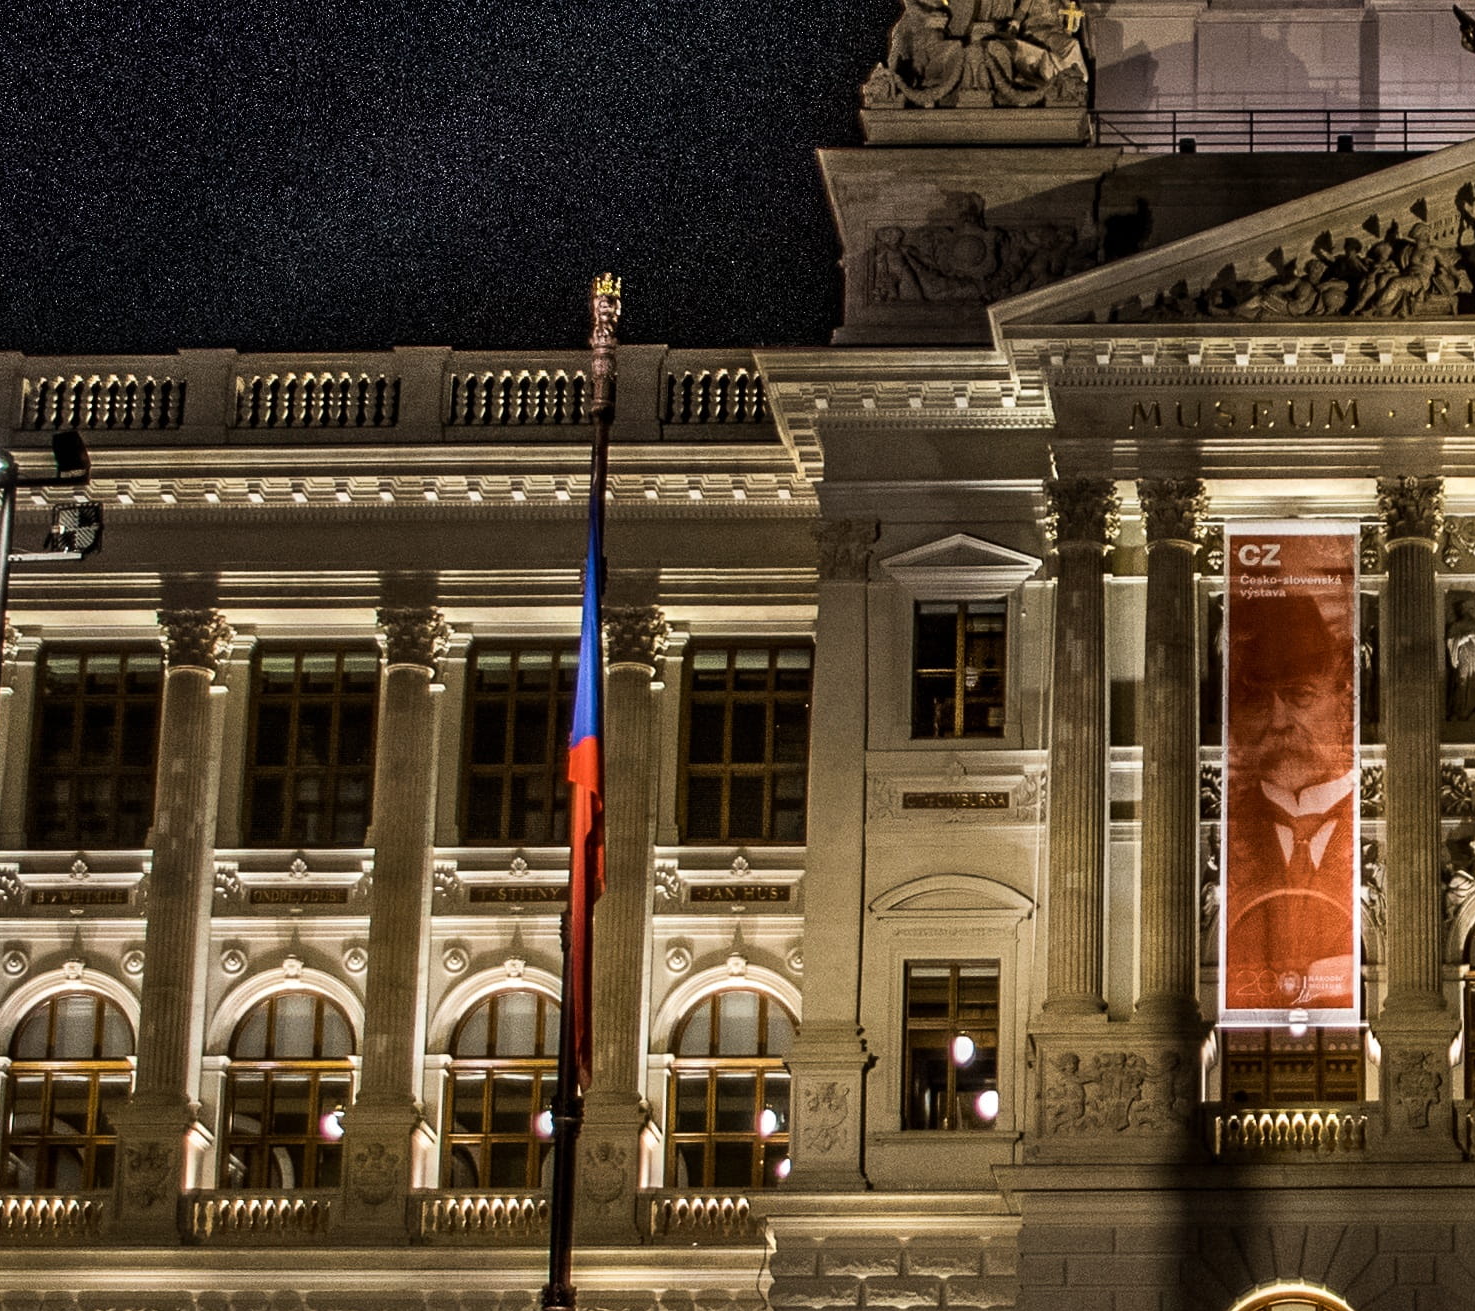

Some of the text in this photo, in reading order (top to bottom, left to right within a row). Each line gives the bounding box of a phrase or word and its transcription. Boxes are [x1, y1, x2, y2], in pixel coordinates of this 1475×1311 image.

[1128, 398, 1361, 430] MUSEUM
[1239, 572, 1343, 585] Česko-slovenská
[1239, 587, 1287, 600] výstava
